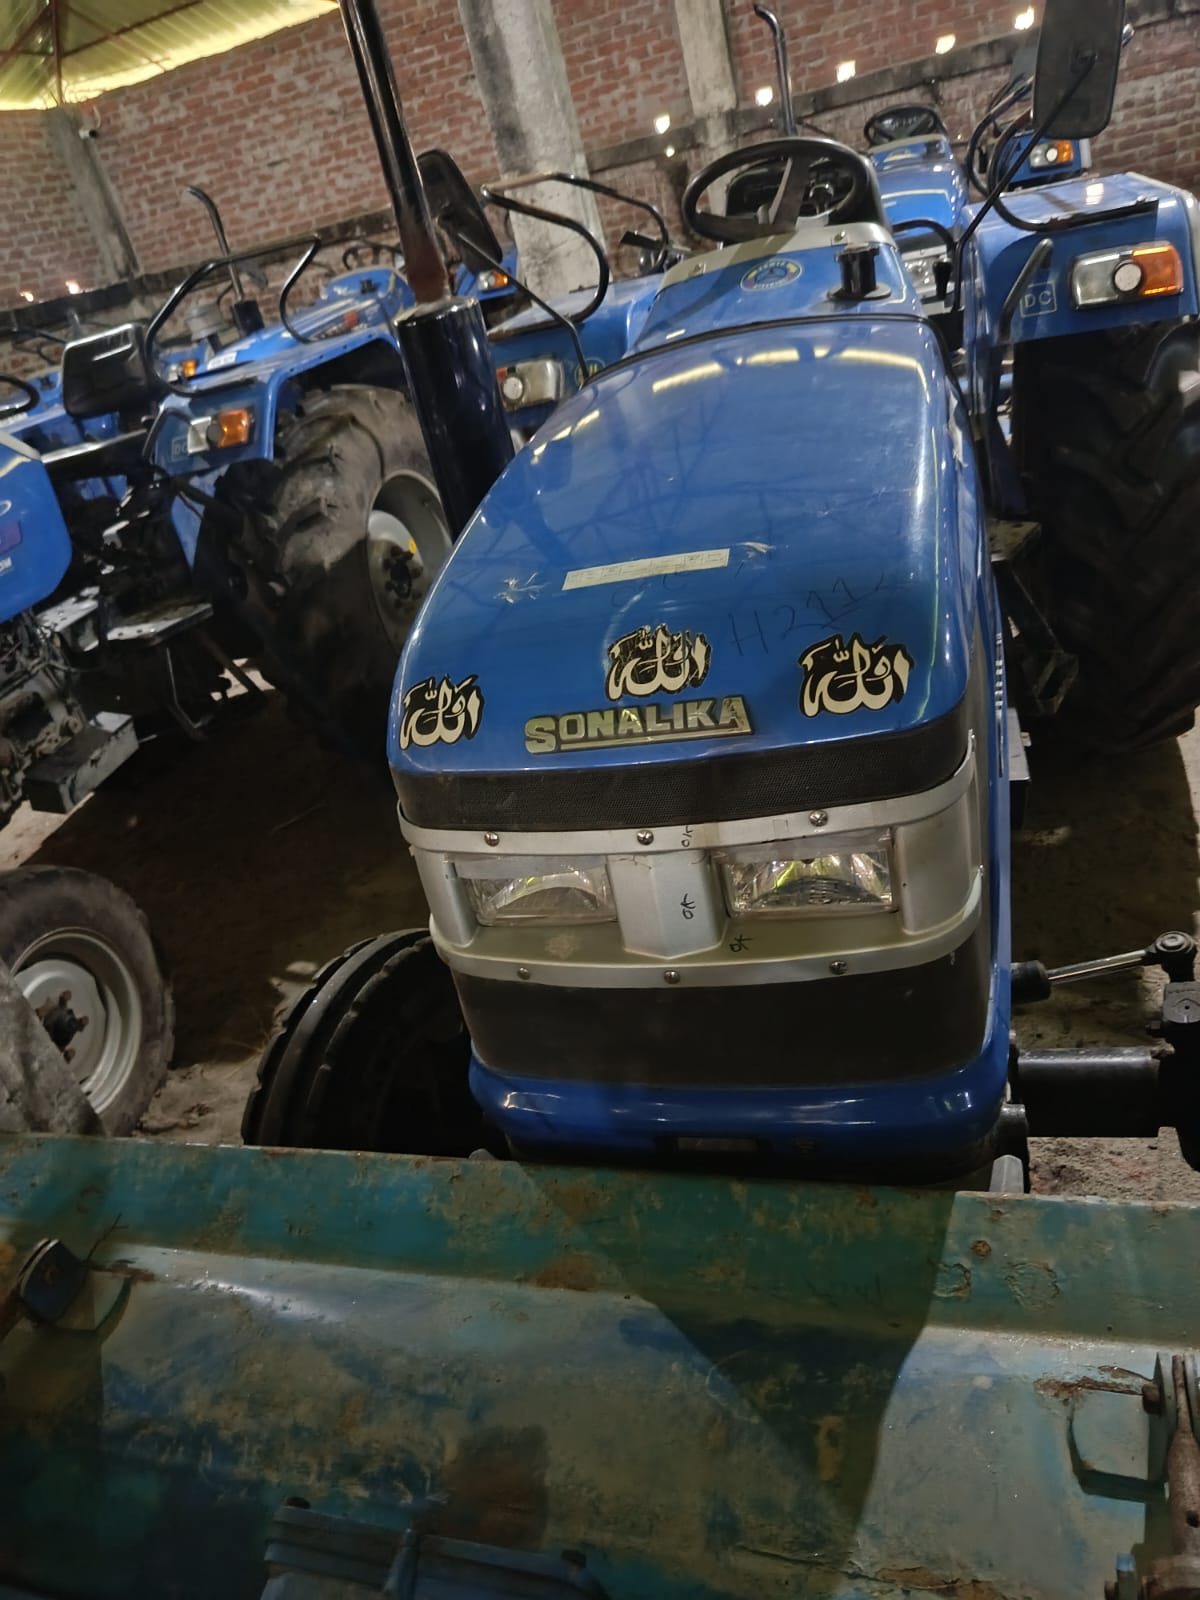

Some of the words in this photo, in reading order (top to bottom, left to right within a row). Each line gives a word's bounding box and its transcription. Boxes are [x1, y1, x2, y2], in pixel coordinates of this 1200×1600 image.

[1024, 291, 1052, 309] DC
[525, 696, 752, 754] SONALIKA
[730, 934, 752, 953] OK
